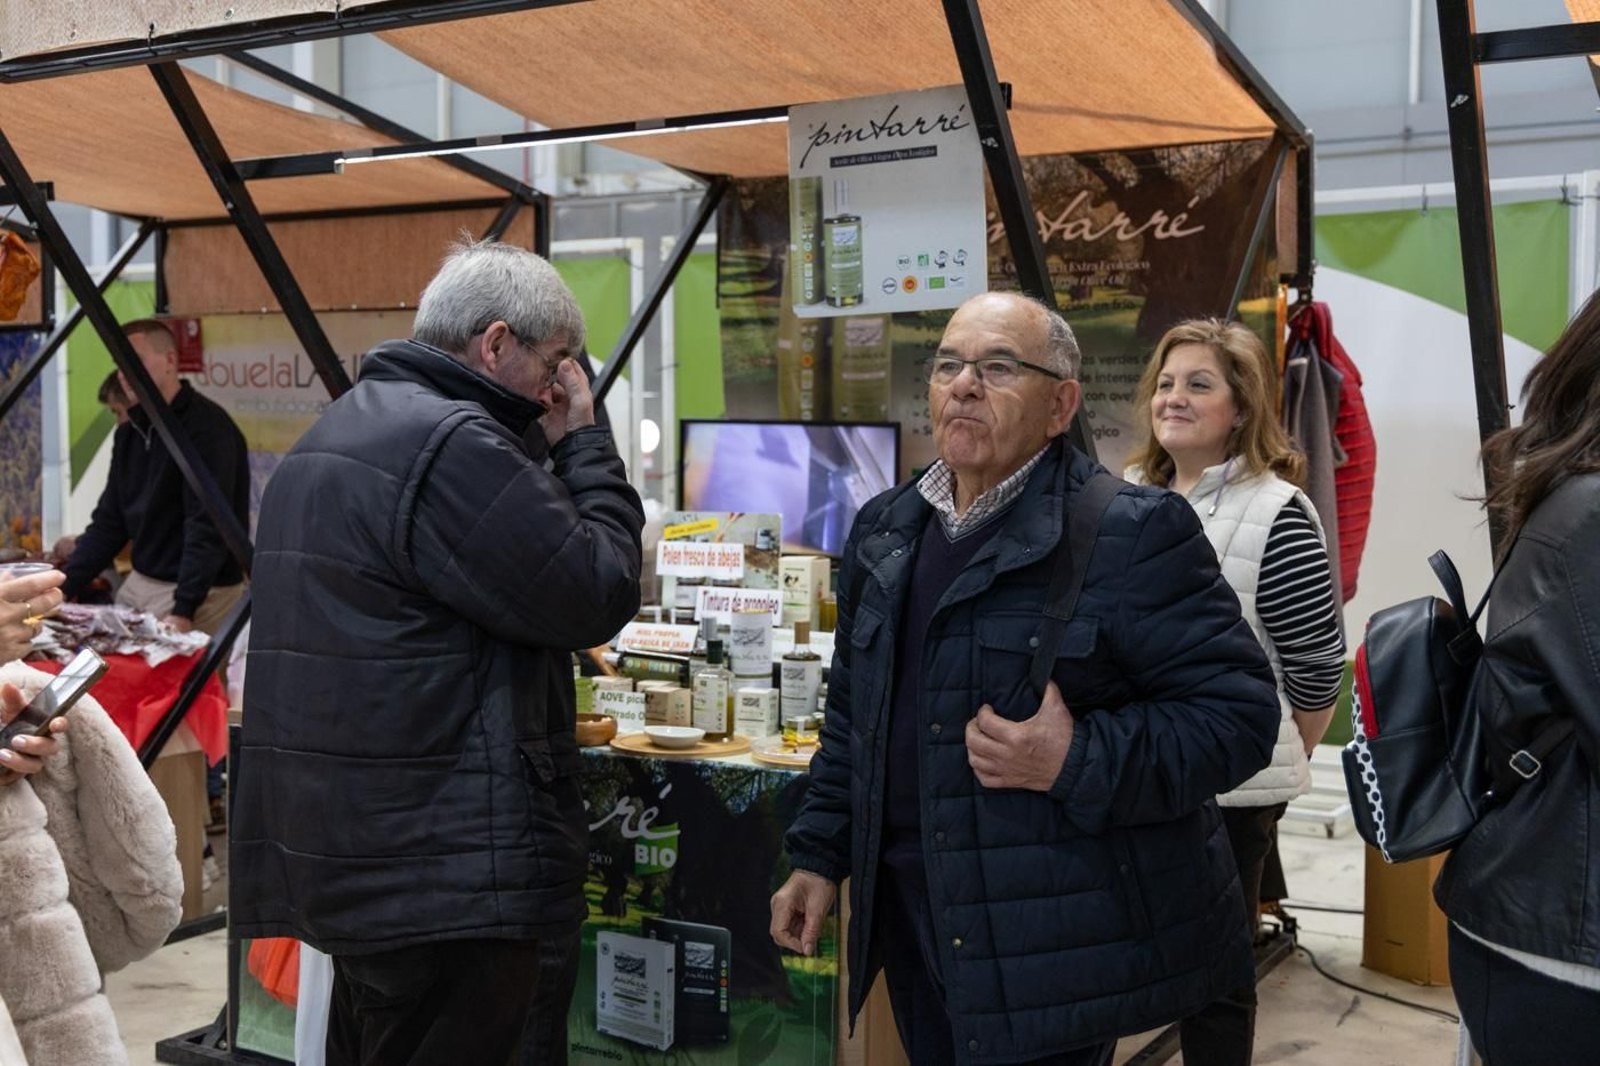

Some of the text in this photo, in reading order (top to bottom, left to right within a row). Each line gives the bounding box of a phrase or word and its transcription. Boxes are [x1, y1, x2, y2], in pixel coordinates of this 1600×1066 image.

[800, 105, 969, 169] pintarré
[1091, 424, 1120, 441] gico
[702, 590, 730, 612] Tintura
[600, 692, 645, 706] AOVE picu
[635, 844, 677, 868] BIO
